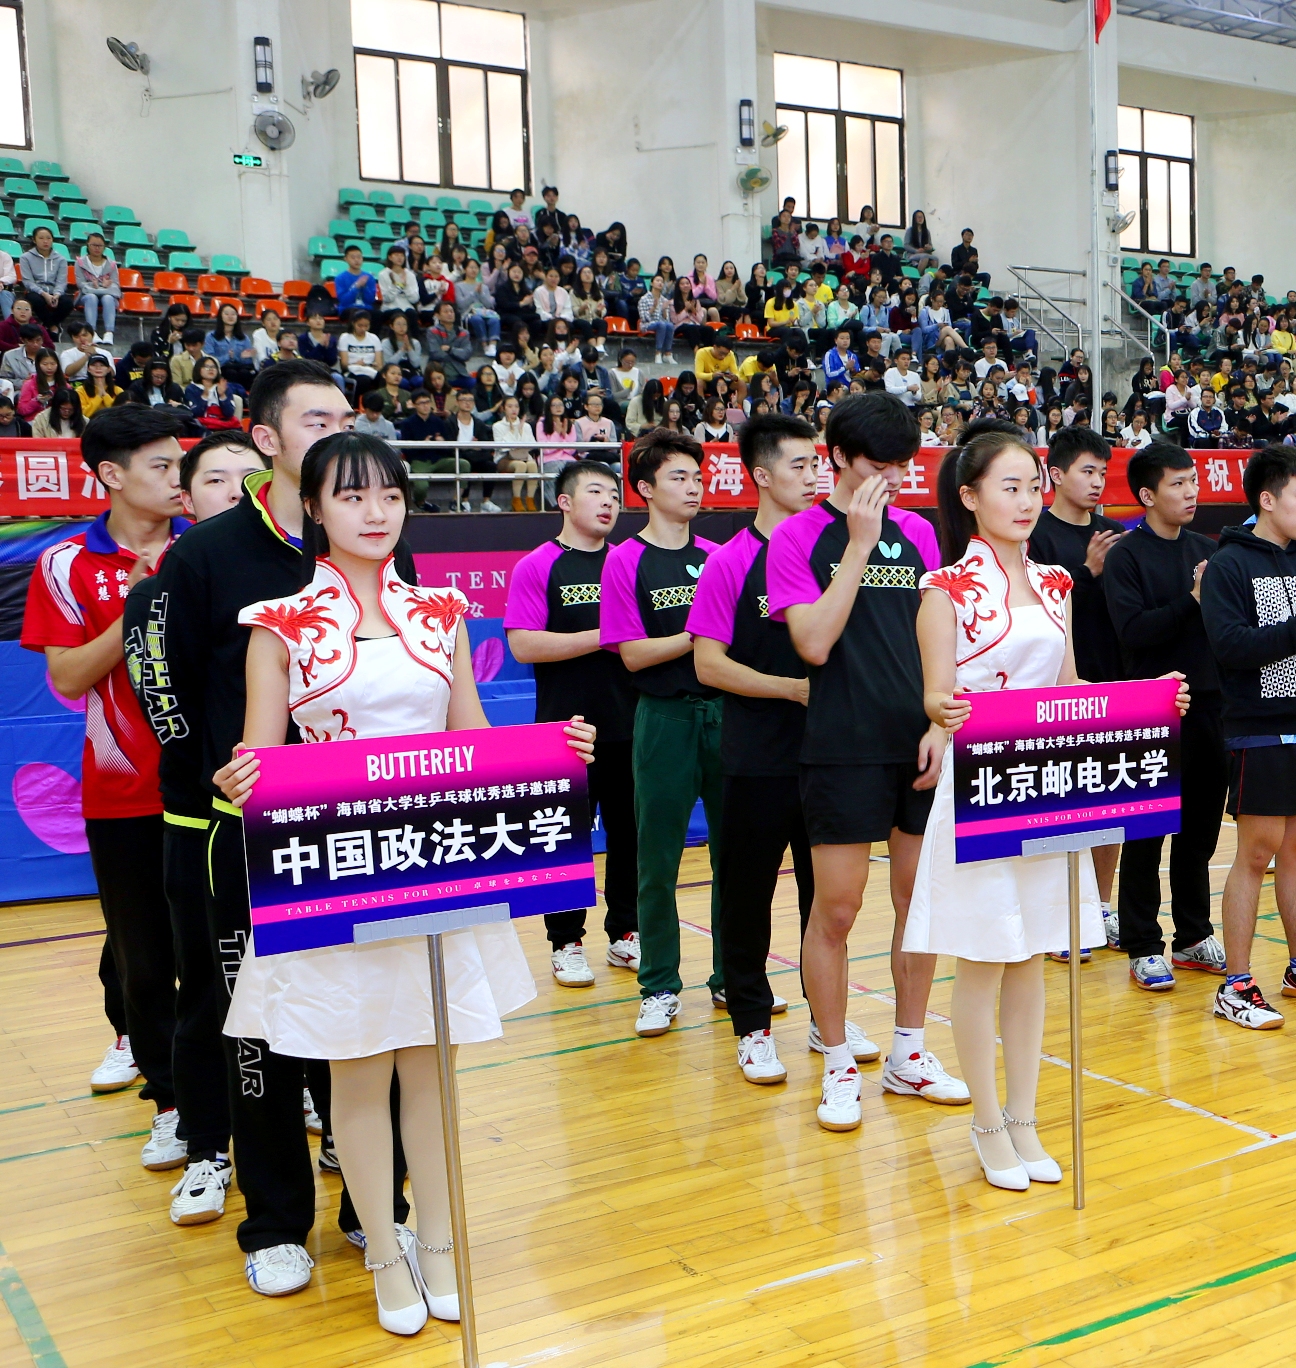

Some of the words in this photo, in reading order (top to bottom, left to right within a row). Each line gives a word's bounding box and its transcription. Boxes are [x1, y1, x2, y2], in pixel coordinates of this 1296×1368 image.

[143, 592, 190, 745] TIBHAR
[1036, 695, 1109, 724] BUTTERFLY
[366, 745, 475, 782] BUTTERFLY
[969, 748, 1169, 807] 北京邮电大学
[1054, 813, 1072, 823] FOR
[1077, 810, 1094, 819] YOU
[272, 806, 573, 886] 中国政法大学
[286, 902, 333, 917] TABLE
[341, 893, 395, 908] TENNIS
[403, 888, 429, 900] FOR
[437, 884, 463, 895] YOU
